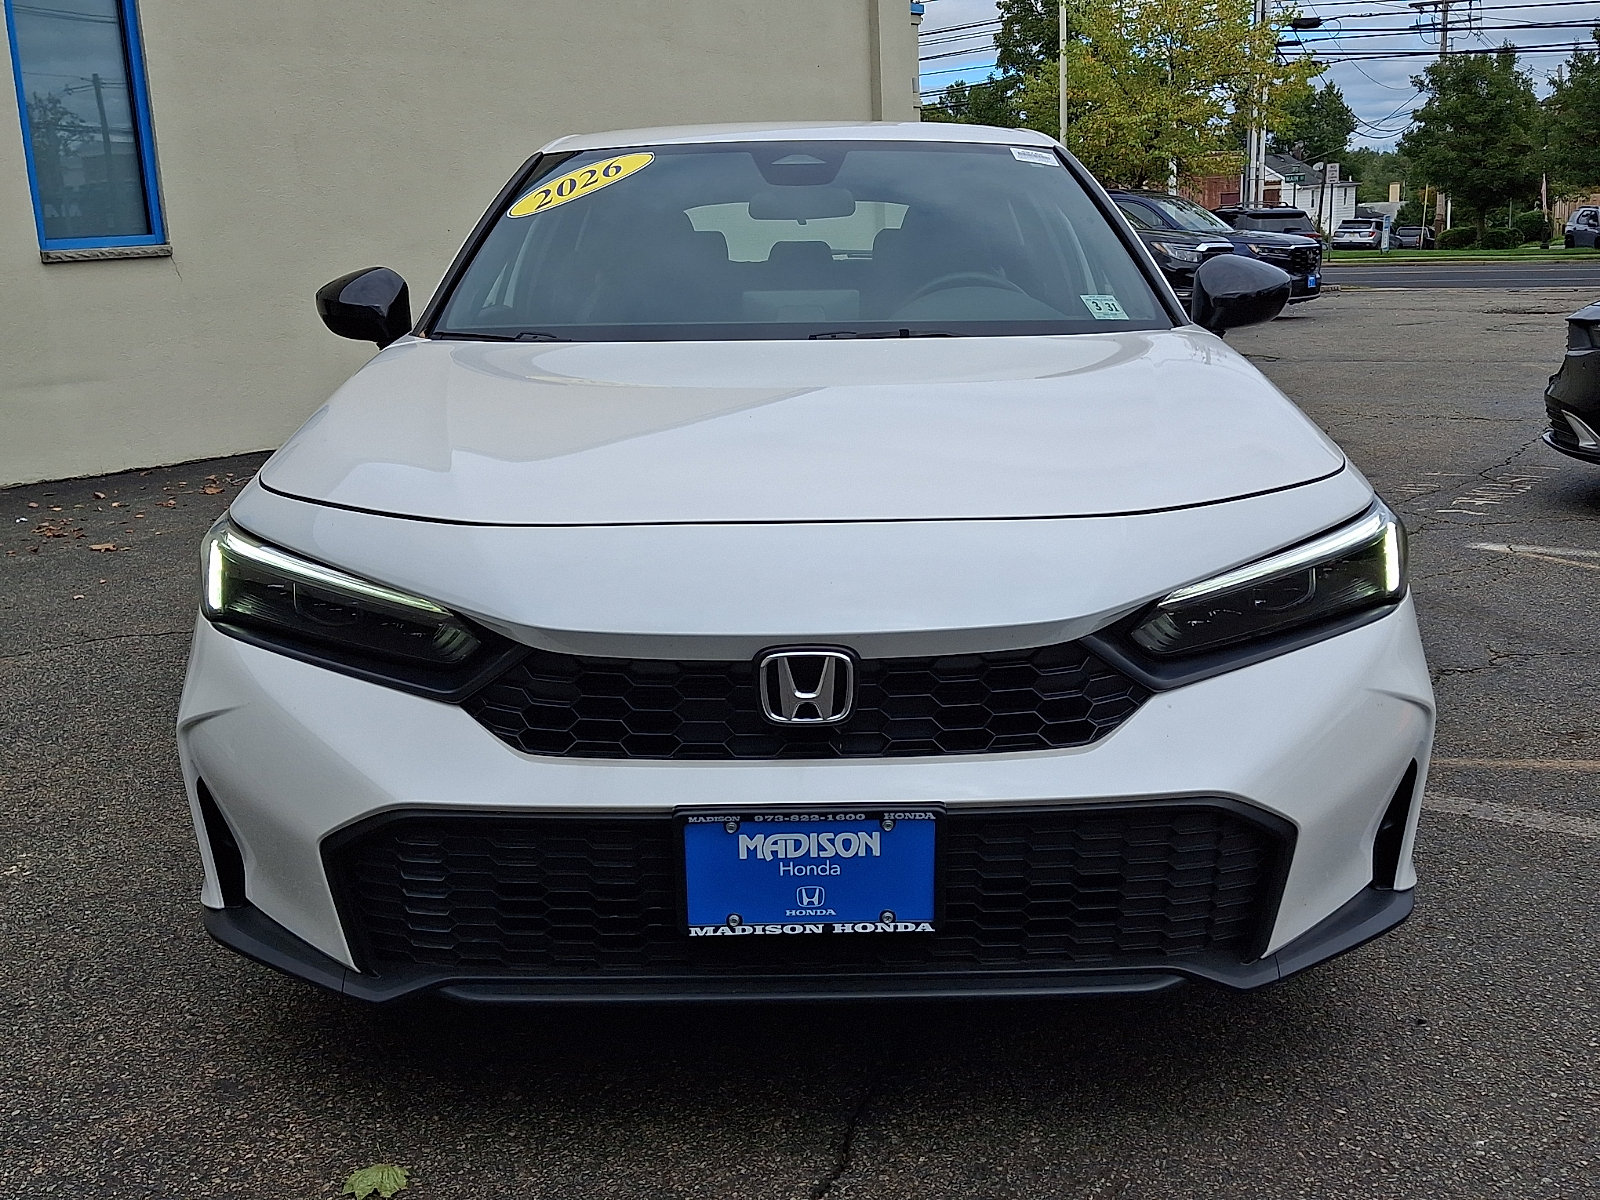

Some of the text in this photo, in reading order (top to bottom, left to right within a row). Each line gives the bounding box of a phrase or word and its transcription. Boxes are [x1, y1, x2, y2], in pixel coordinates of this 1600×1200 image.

[533, 158, 622, 210] 2026
[1091, 301, 1121, 312] 3 31
[754, 813, 866, 822] 973-822-1600
[883, 812, 936, 820] HONDA
[738, 831, 881, 861] MADISON
[779, 860, 841, 876] Honda
[785, 909, 837, 917] HONDA
[689, 922, 936, 937] MADISON HONDA
